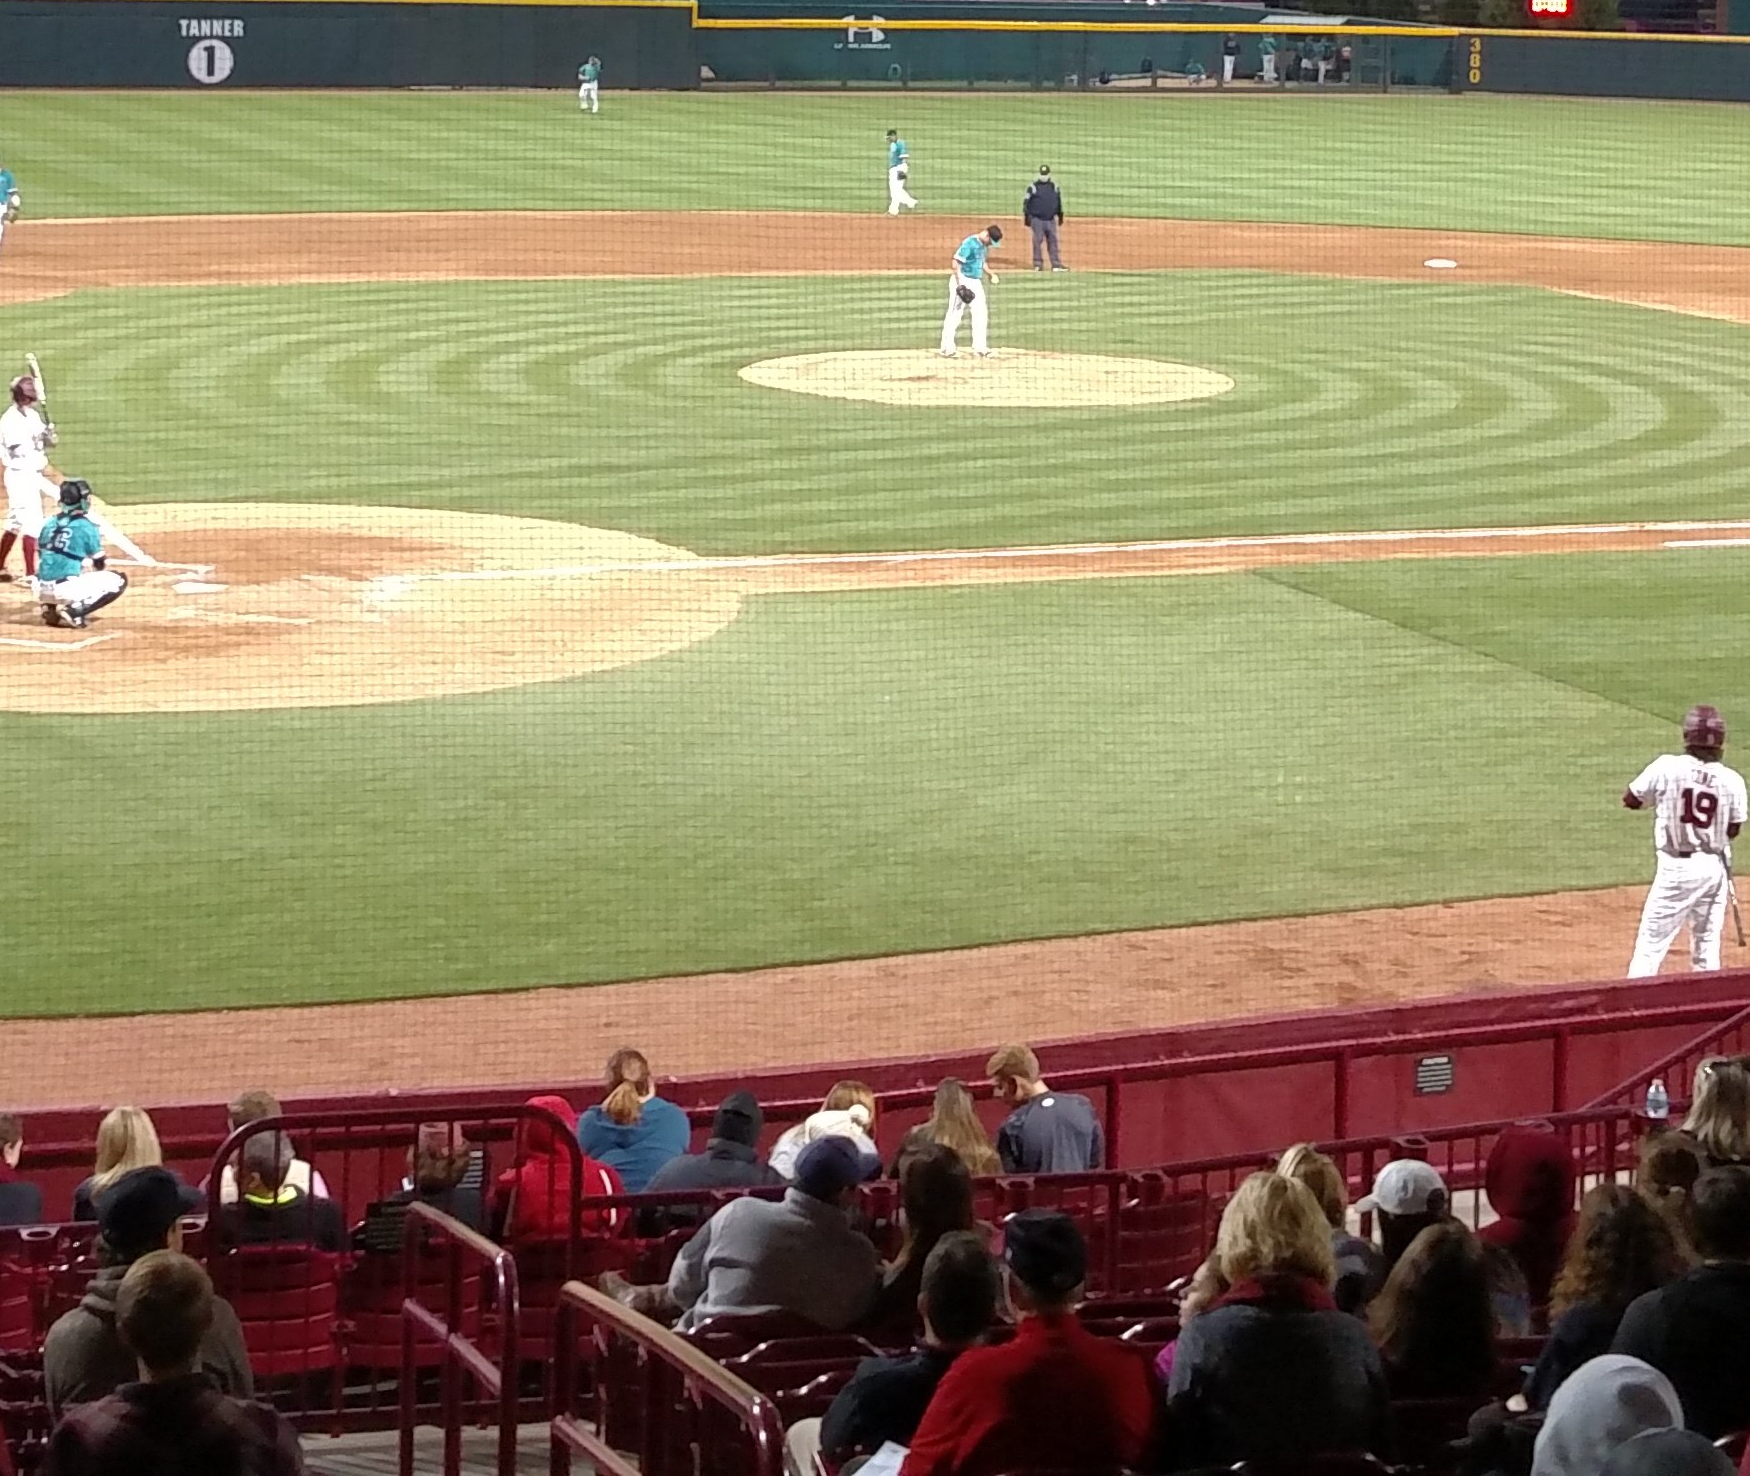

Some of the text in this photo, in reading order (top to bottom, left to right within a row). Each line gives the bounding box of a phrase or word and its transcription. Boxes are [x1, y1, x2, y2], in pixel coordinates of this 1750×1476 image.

[178, 18, 245, 38] TANNER
[202, 44, 216, 78] 1
[1679, 787, 1719, 830] 19
